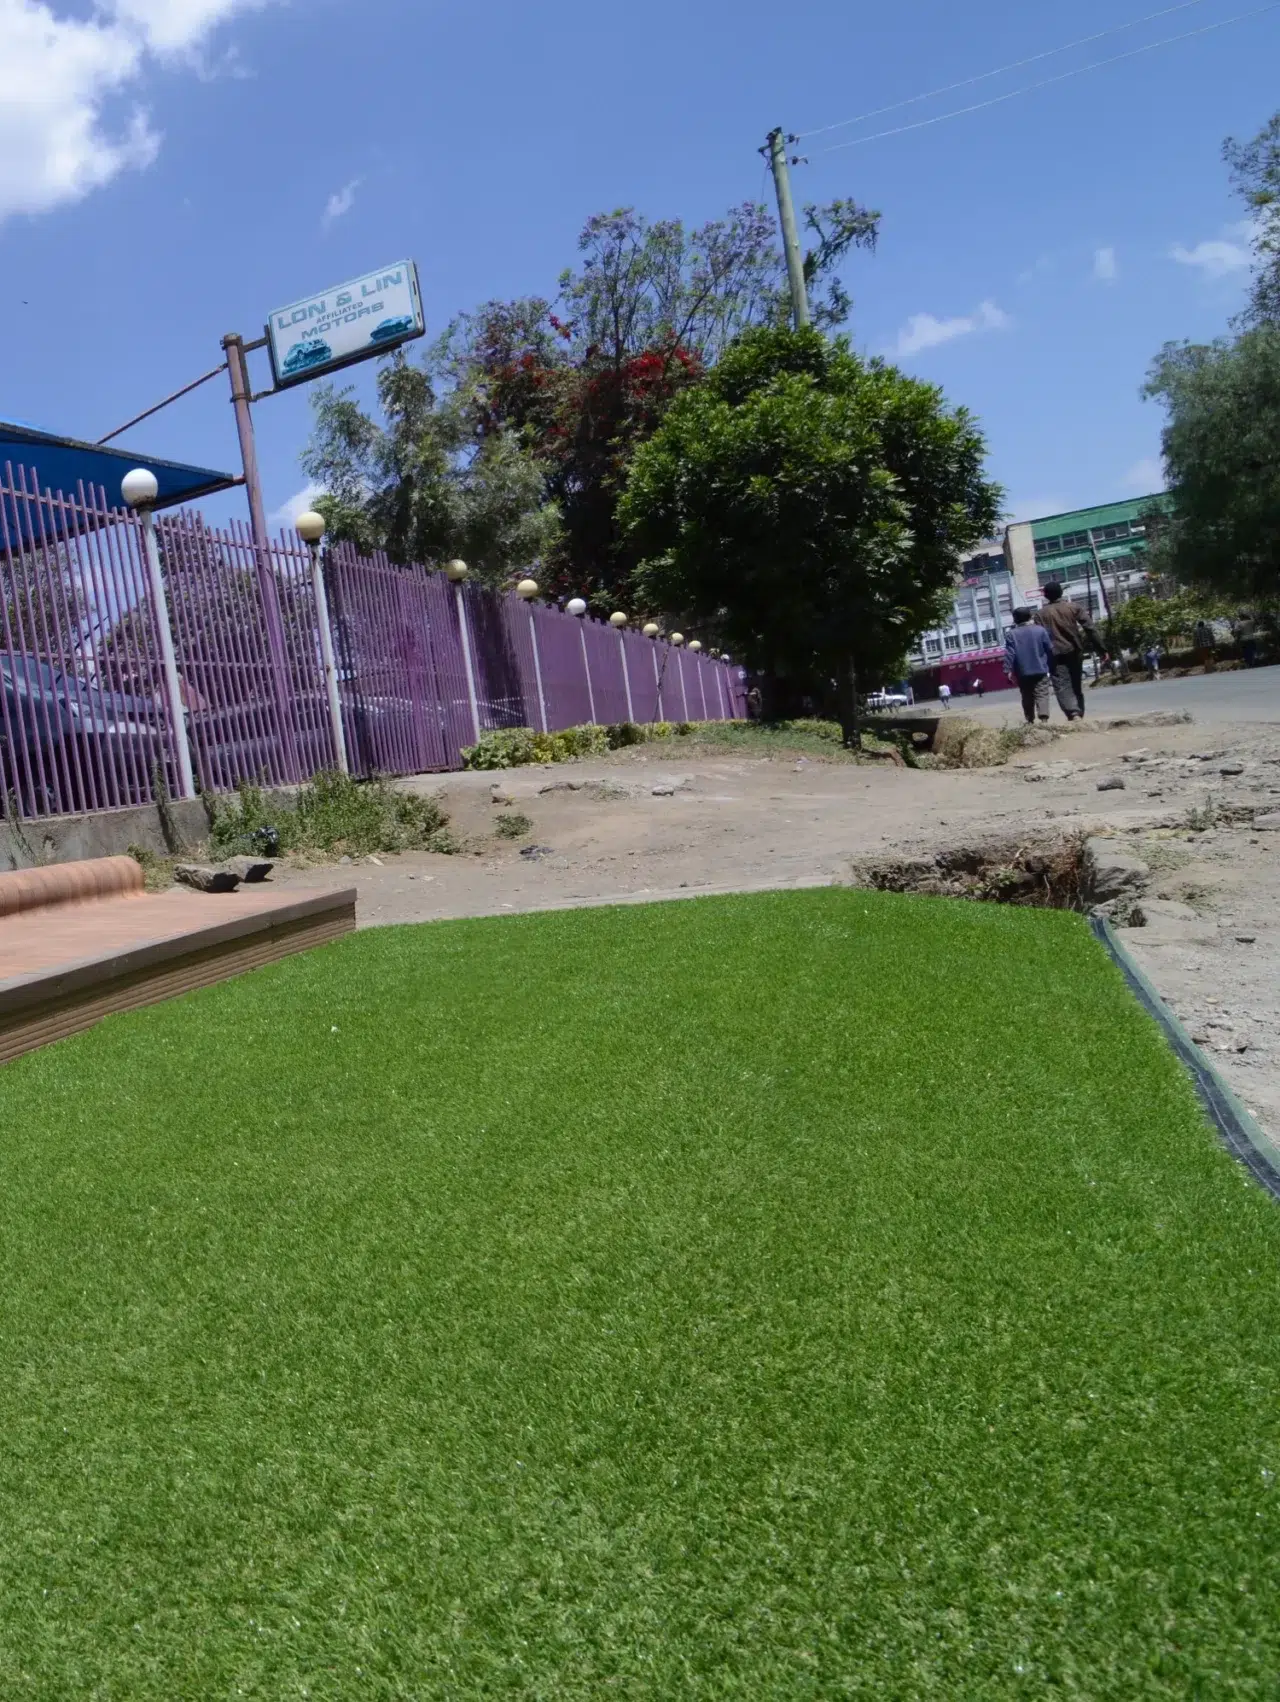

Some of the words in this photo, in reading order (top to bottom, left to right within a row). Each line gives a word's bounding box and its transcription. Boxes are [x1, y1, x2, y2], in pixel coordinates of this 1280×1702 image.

[278, 300, 326, 330] LON
[336, 291, 352, 307] &
[361, 272, 402, 297] LIN
[301, 301, 384, 339] MOTORS
[317, 301, 363, 324] AFFILIATED
